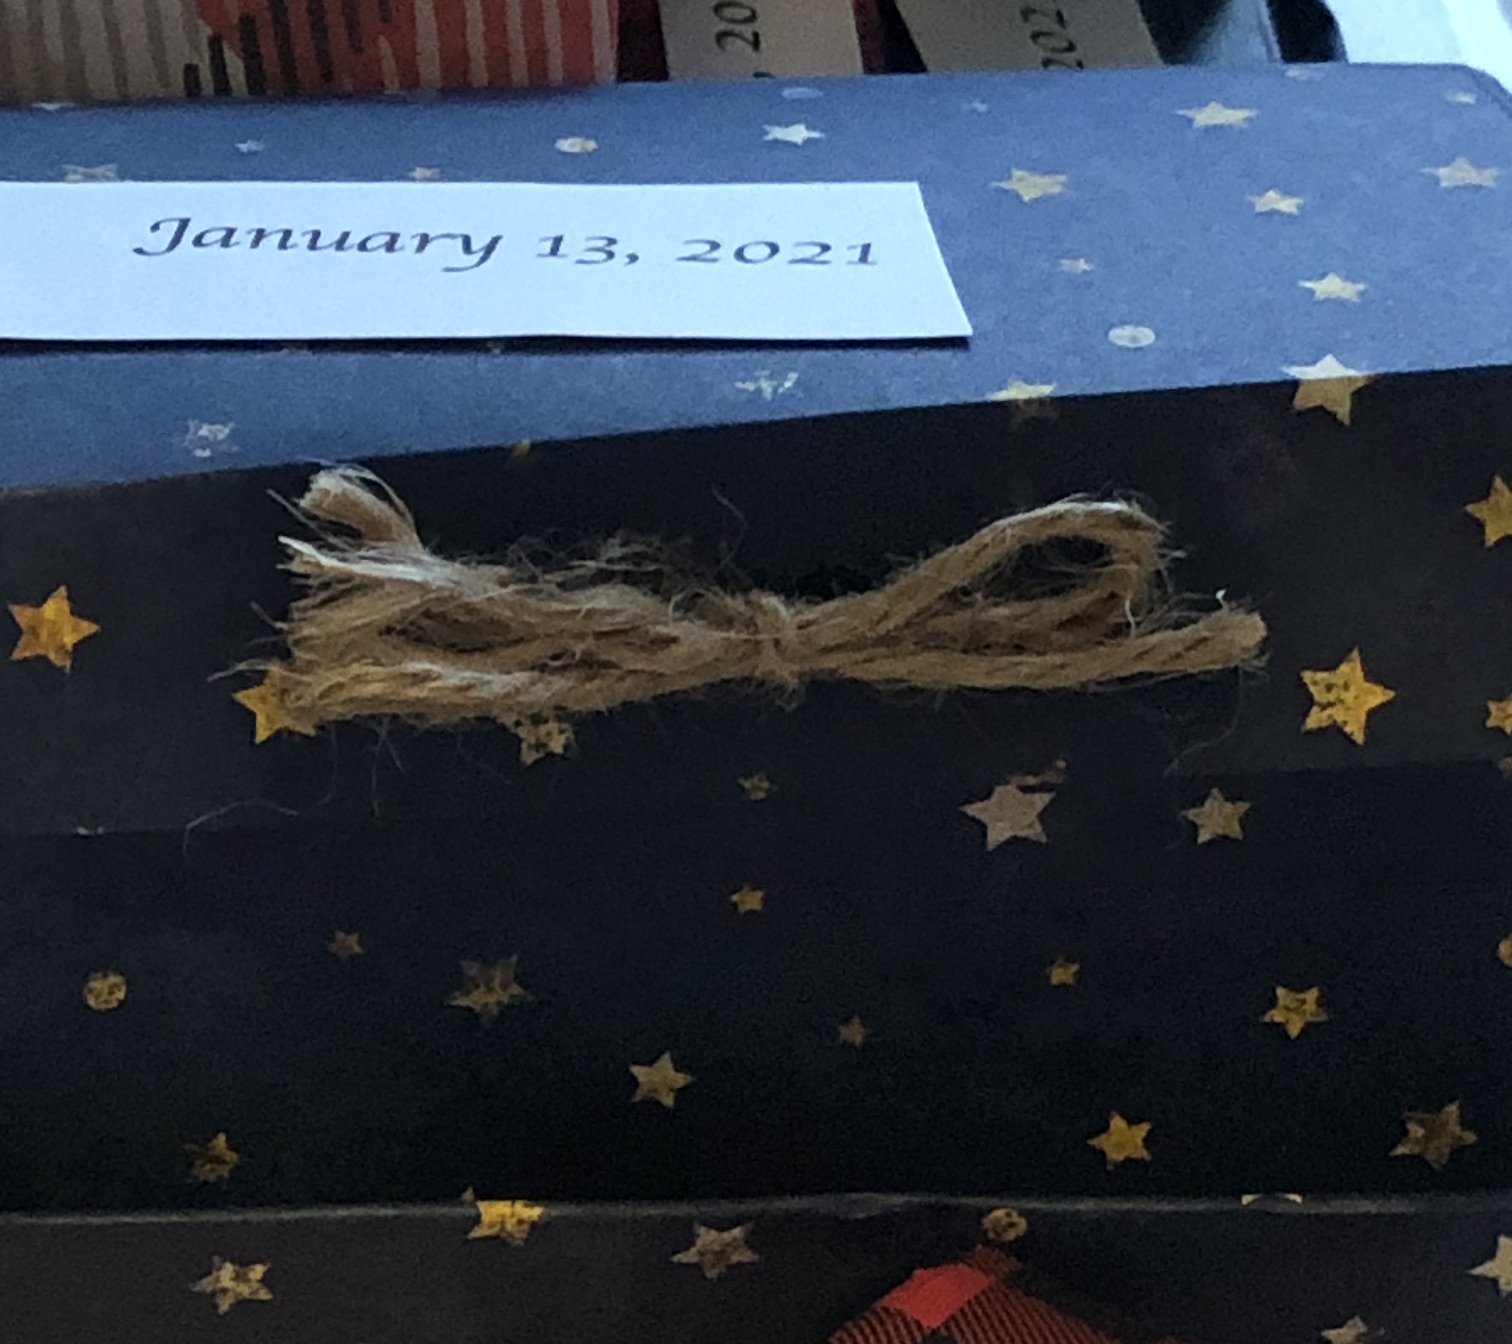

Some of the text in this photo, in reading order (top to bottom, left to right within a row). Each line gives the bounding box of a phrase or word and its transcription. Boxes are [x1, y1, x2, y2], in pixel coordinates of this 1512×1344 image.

[132, 217, 878, 273] January 13, 2021
